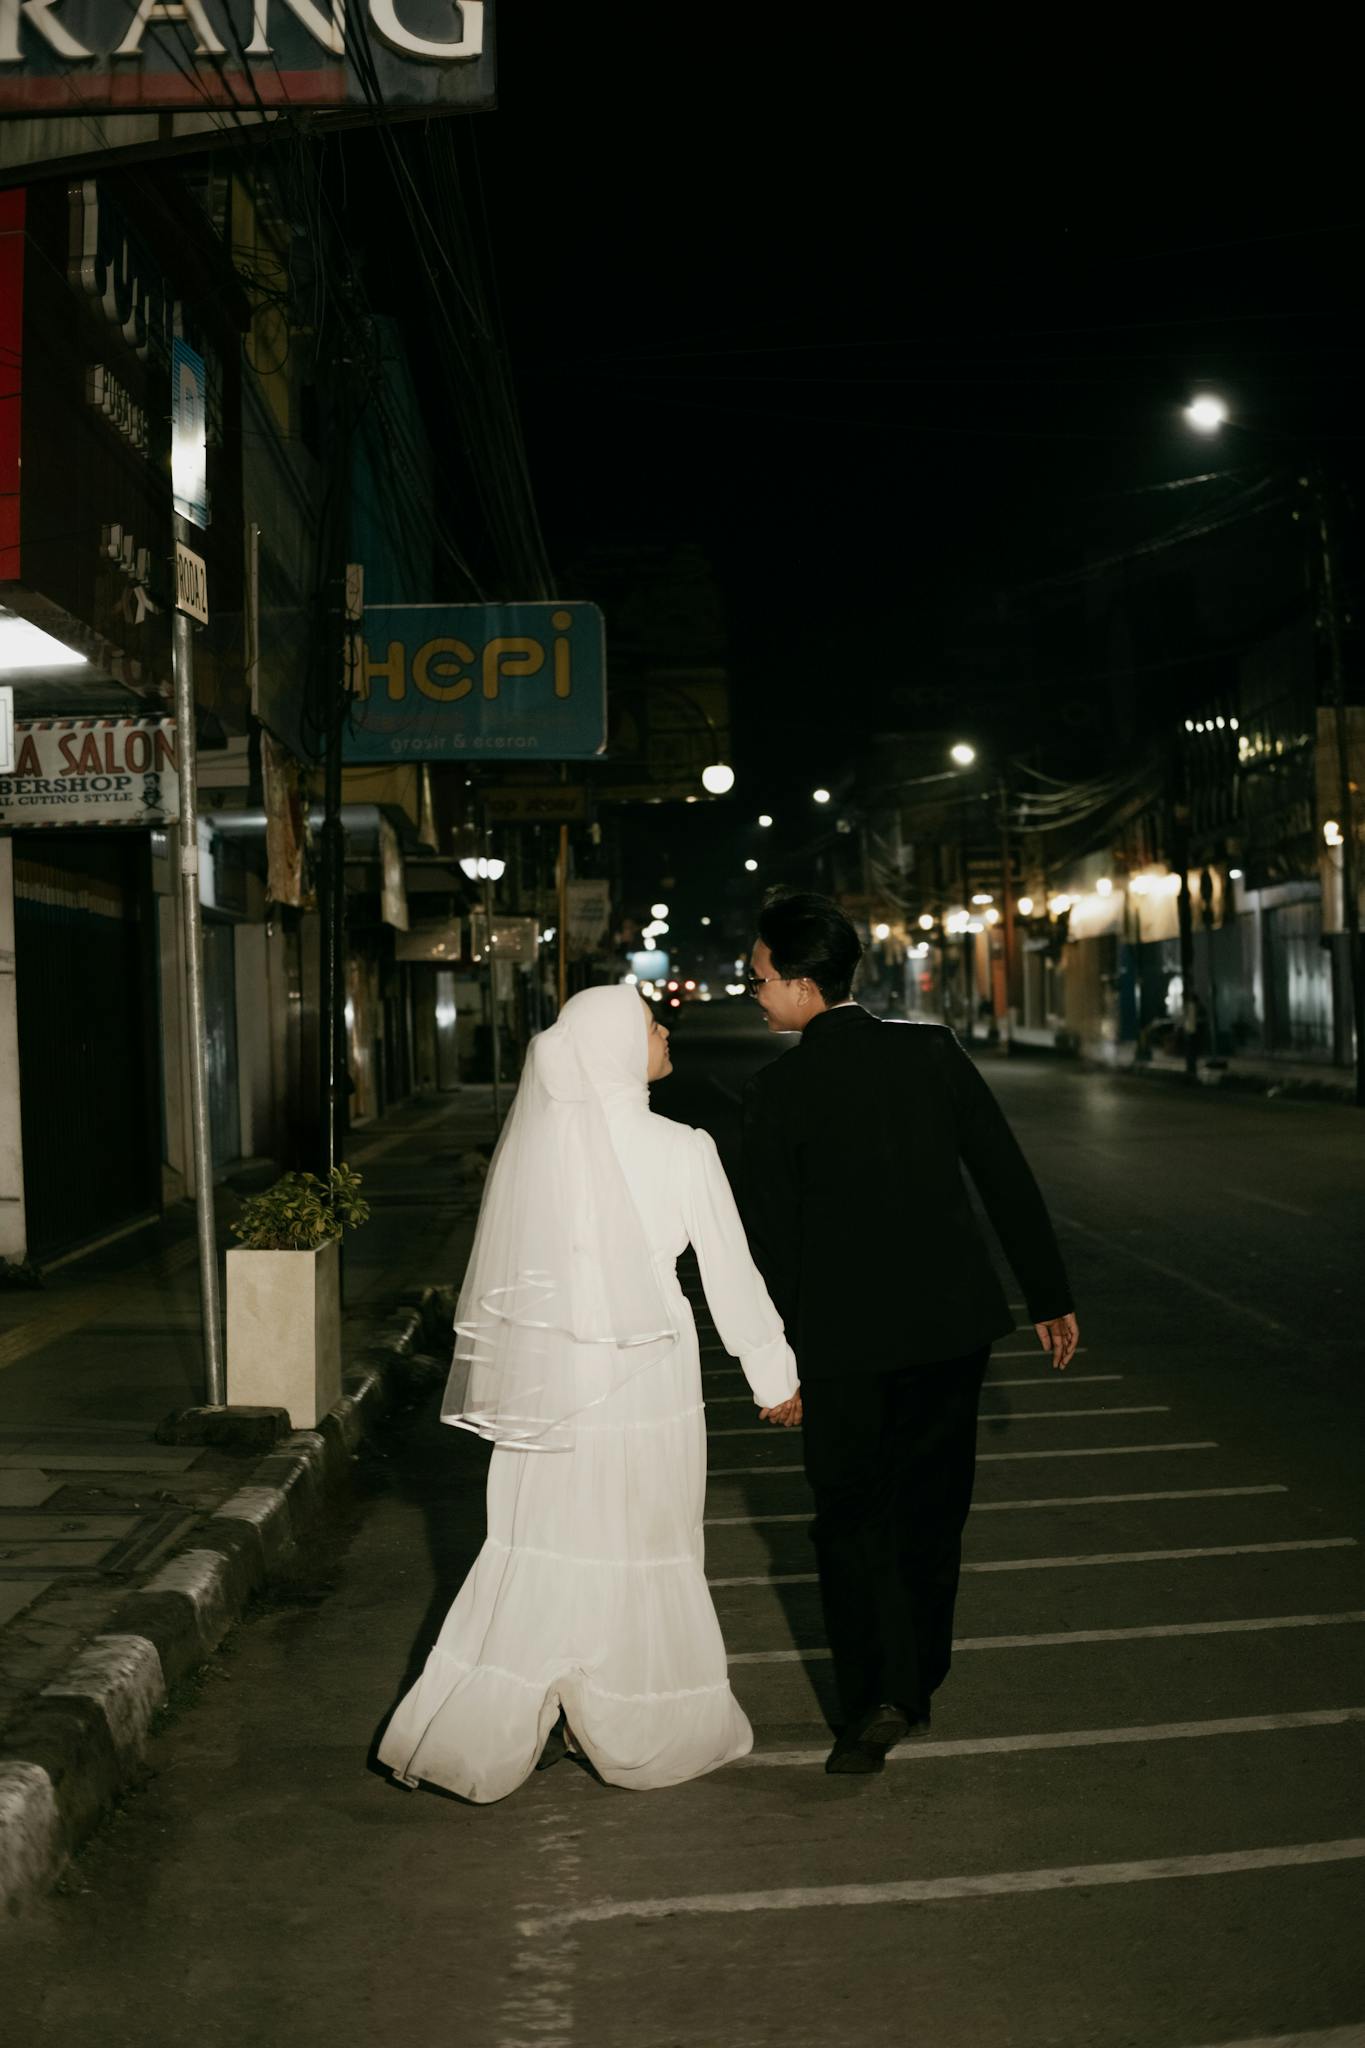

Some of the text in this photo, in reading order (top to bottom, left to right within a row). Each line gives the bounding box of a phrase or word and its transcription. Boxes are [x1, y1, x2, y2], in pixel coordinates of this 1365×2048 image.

[178, 553, 200, 610] RODA
[200, 568, 206, 613] 2
[58, 731, 179, 775] SALON
[389, 735, 539, 754] grosir & eceran
[18, 794, 80, 806] CUTING
[83, 792, 133, 803] STYLE
